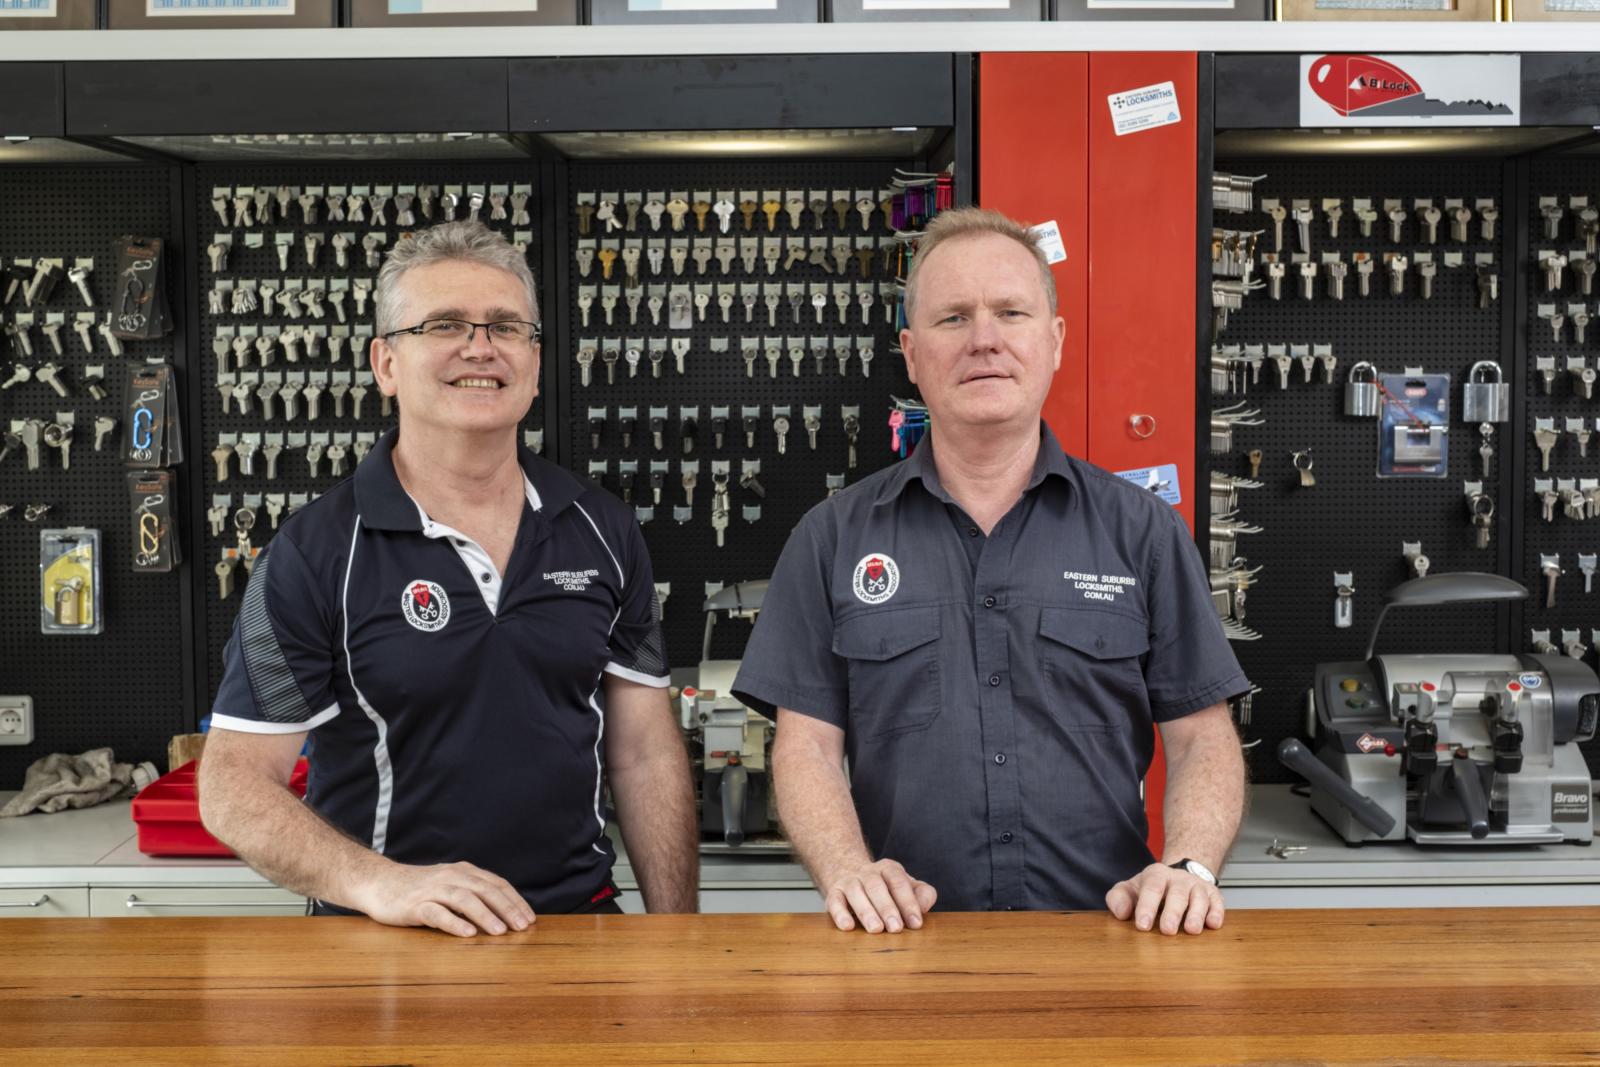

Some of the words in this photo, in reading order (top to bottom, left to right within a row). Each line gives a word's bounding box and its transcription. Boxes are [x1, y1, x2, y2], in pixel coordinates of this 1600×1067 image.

[1126, 90, 1173, 106] LOCKSMITHS
[543, 571, 570, 580] EASTERN
[1063, 571, 1098, 582] EASTERN
[1101, 574, 1136, 586] SUBURBS
[430, 583, 448, 620] ASSOCIATION
[1084, 591, 1114, 601] COM.AU
[1553, 792, 1588, 804] Bravo
